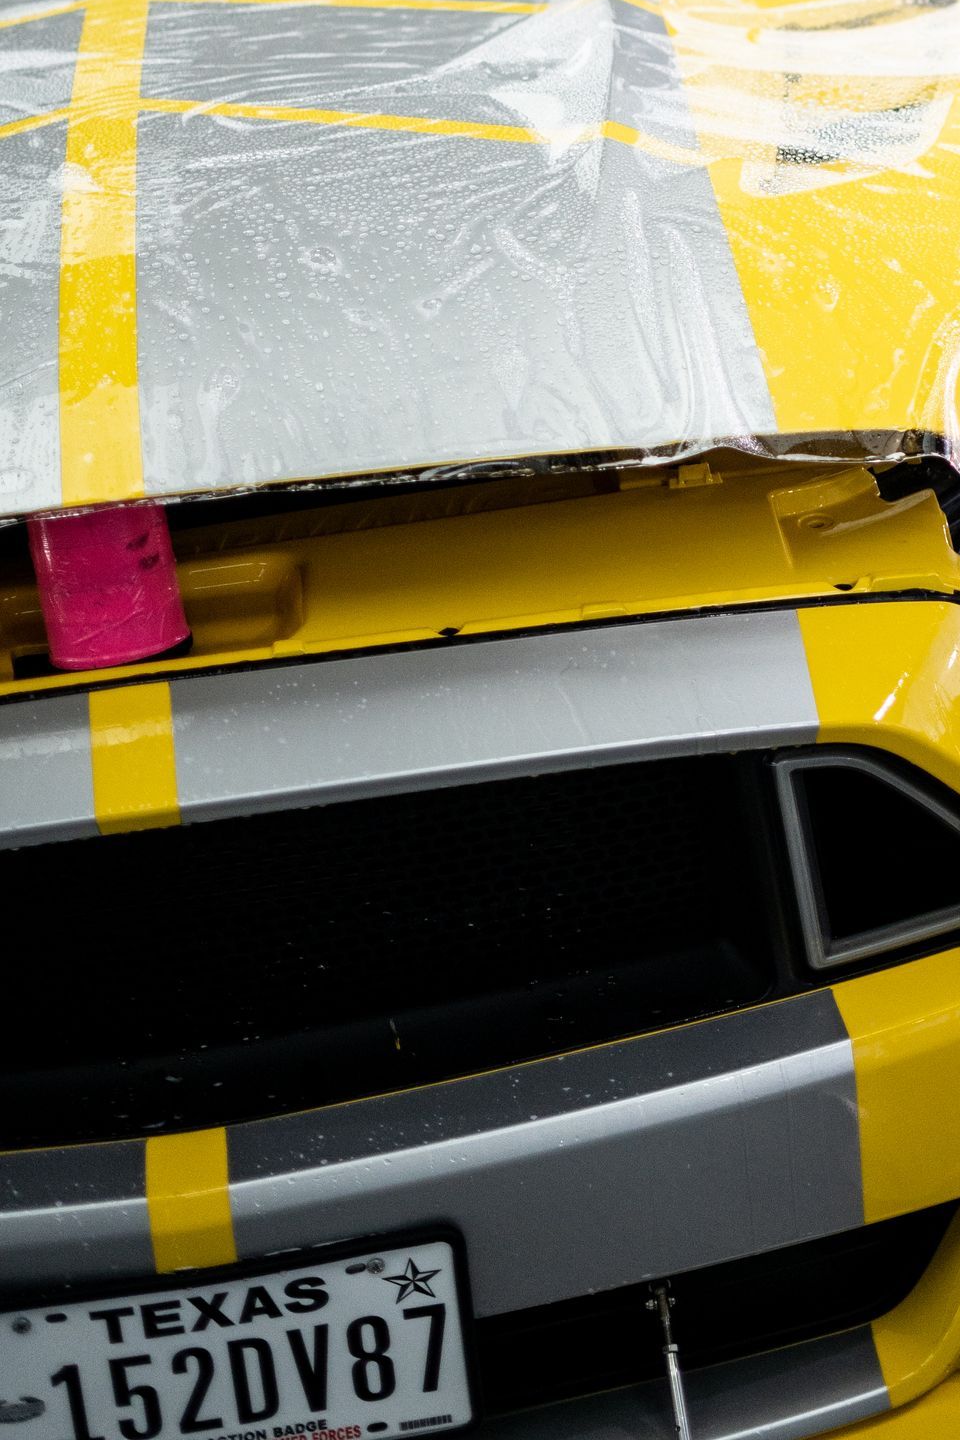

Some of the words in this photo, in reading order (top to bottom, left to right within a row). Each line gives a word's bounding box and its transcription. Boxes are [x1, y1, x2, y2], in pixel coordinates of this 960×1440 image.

[90, 1276, 330, 1344] TEXAS
[50, 1303, 447, 1440] 152DV87
[273, 1419, 328, 1437] BADGE
[312, 1425, 362, 1440] FORCES
